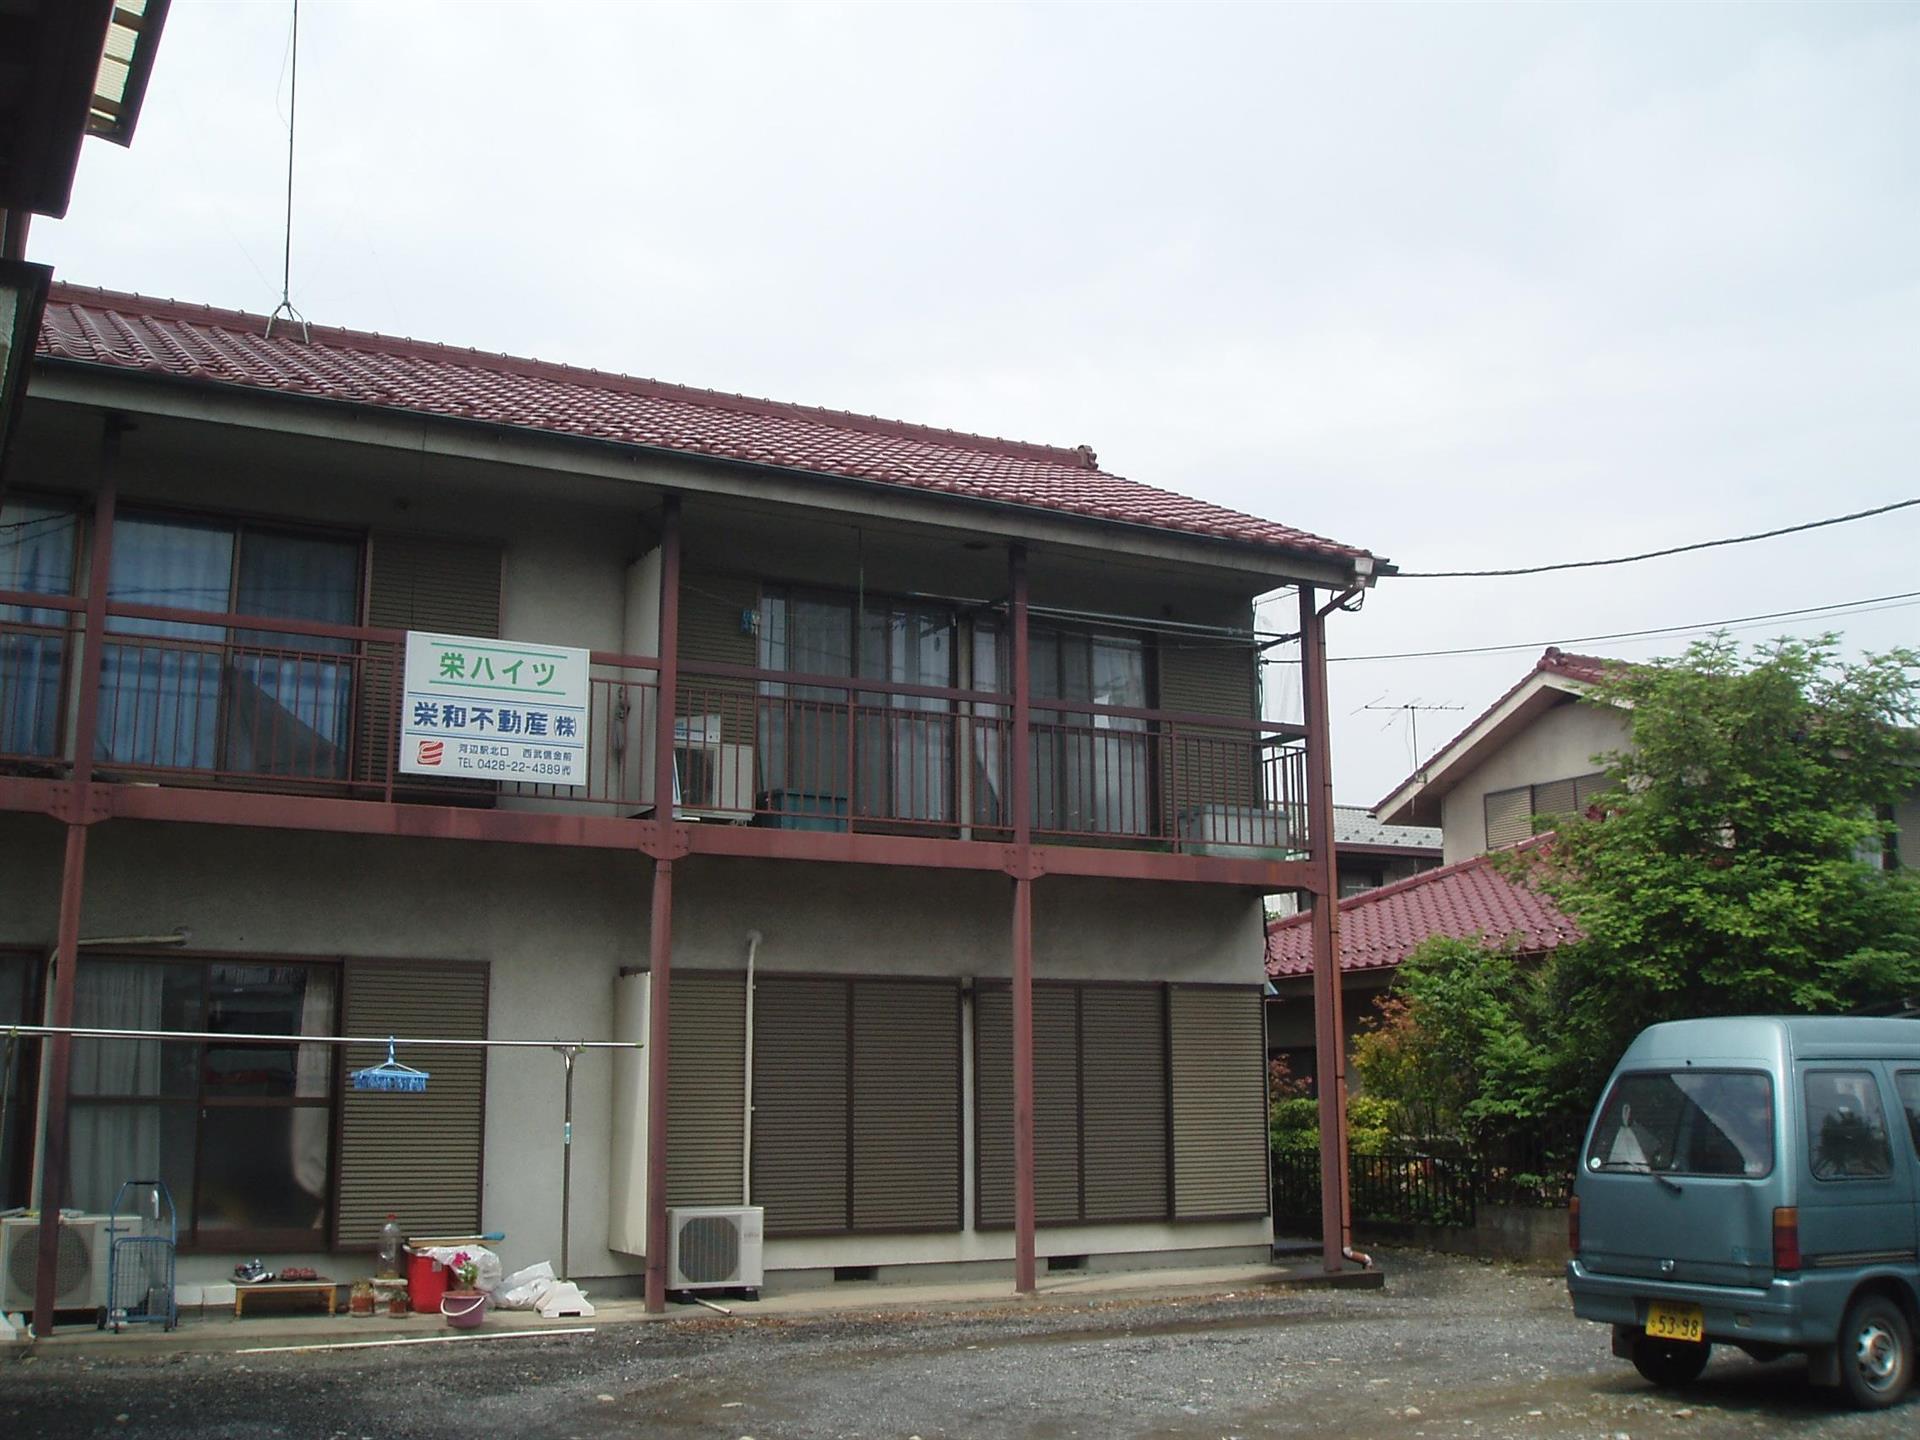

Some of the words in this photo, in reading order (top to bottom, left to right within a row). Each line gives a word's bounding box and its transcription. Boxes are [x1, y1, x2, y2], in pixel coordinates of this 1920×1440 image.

[440, 652, 555, 686] 栄ハイツ
[458, 757, 473, 768] TEL
